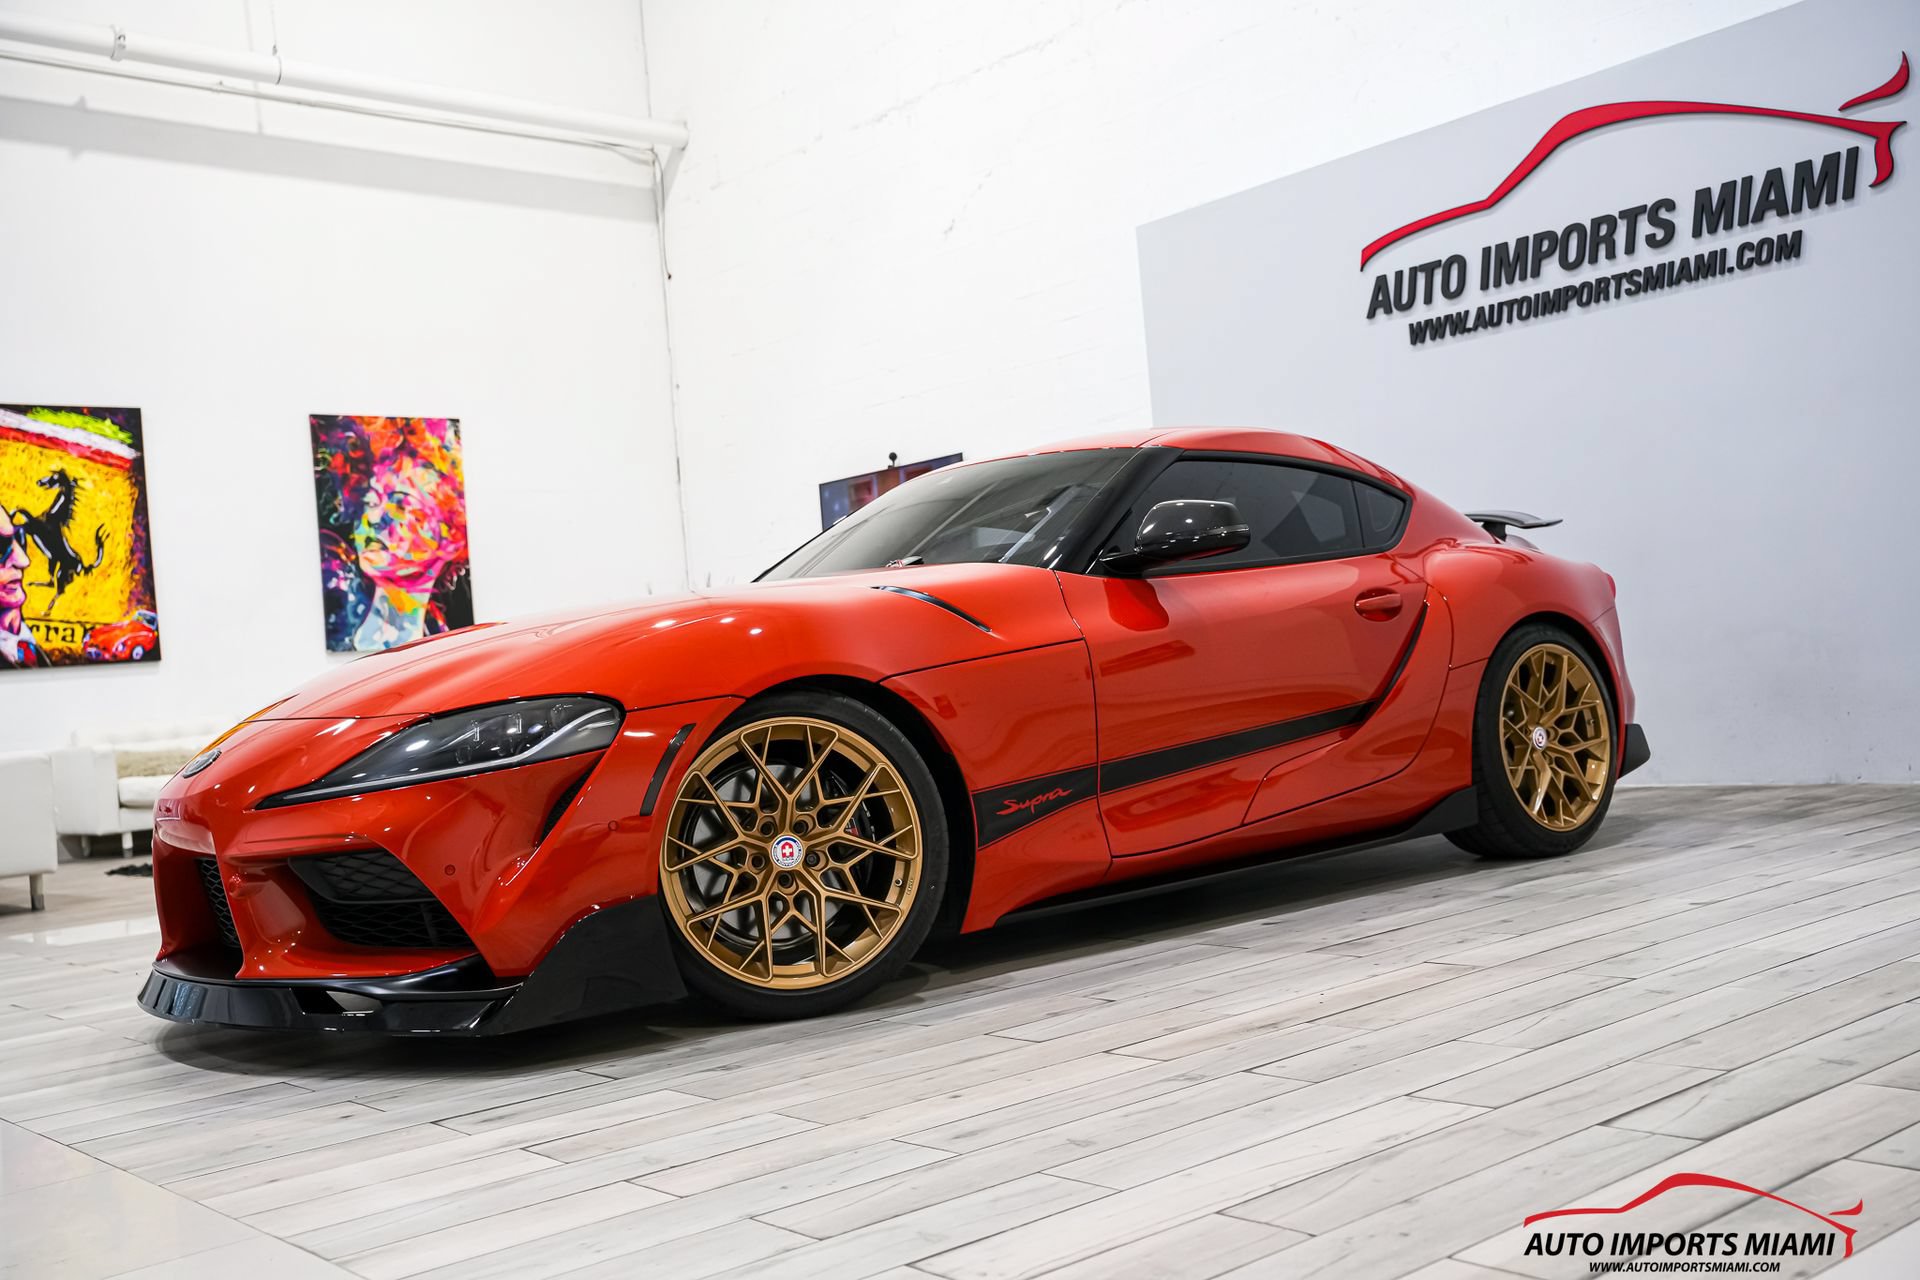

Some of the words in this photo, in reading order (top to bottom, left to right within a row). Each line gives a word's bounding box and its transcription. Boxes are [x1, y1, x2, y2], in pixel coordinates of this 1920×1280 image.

[1366, 254, 1467, 320] AUTO
[1480, 198, 1676, 291] IMPORTS
[1692, 146, 1860, 239] MIAMI
[1409, 230, 1803, 346] WWW.AUTOIMPORTSMIAMI.COM
[996, 788, 1073, 815] Supra
